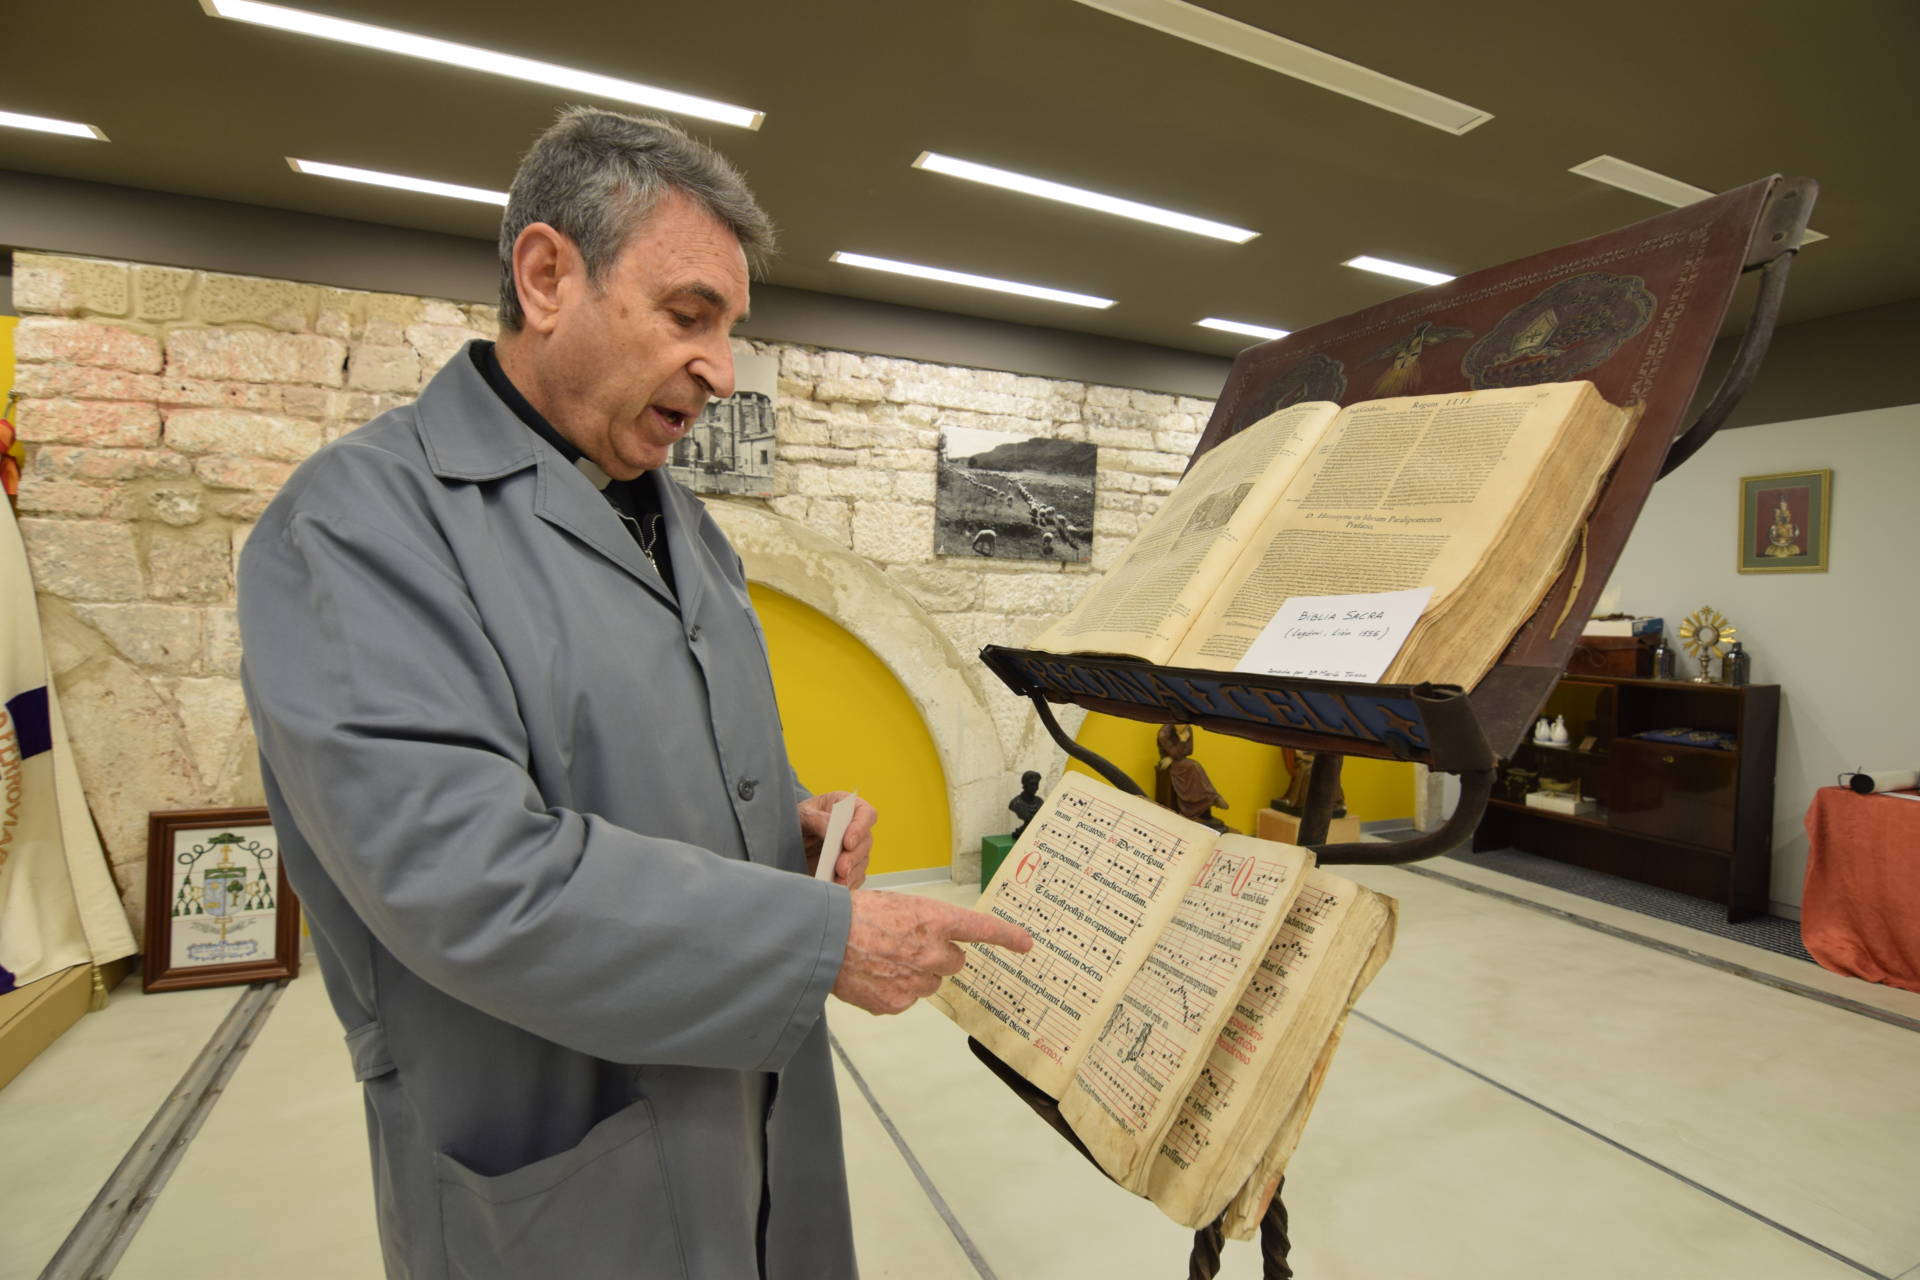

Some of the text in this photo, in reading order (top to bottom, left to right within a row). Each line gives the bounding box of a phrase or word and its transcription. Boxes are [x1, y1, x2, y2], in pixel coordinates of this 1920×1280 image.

[1297, 610, 1385, 621] BIBLIA SACRA
[1217, 684, 1381, 742] CELI
